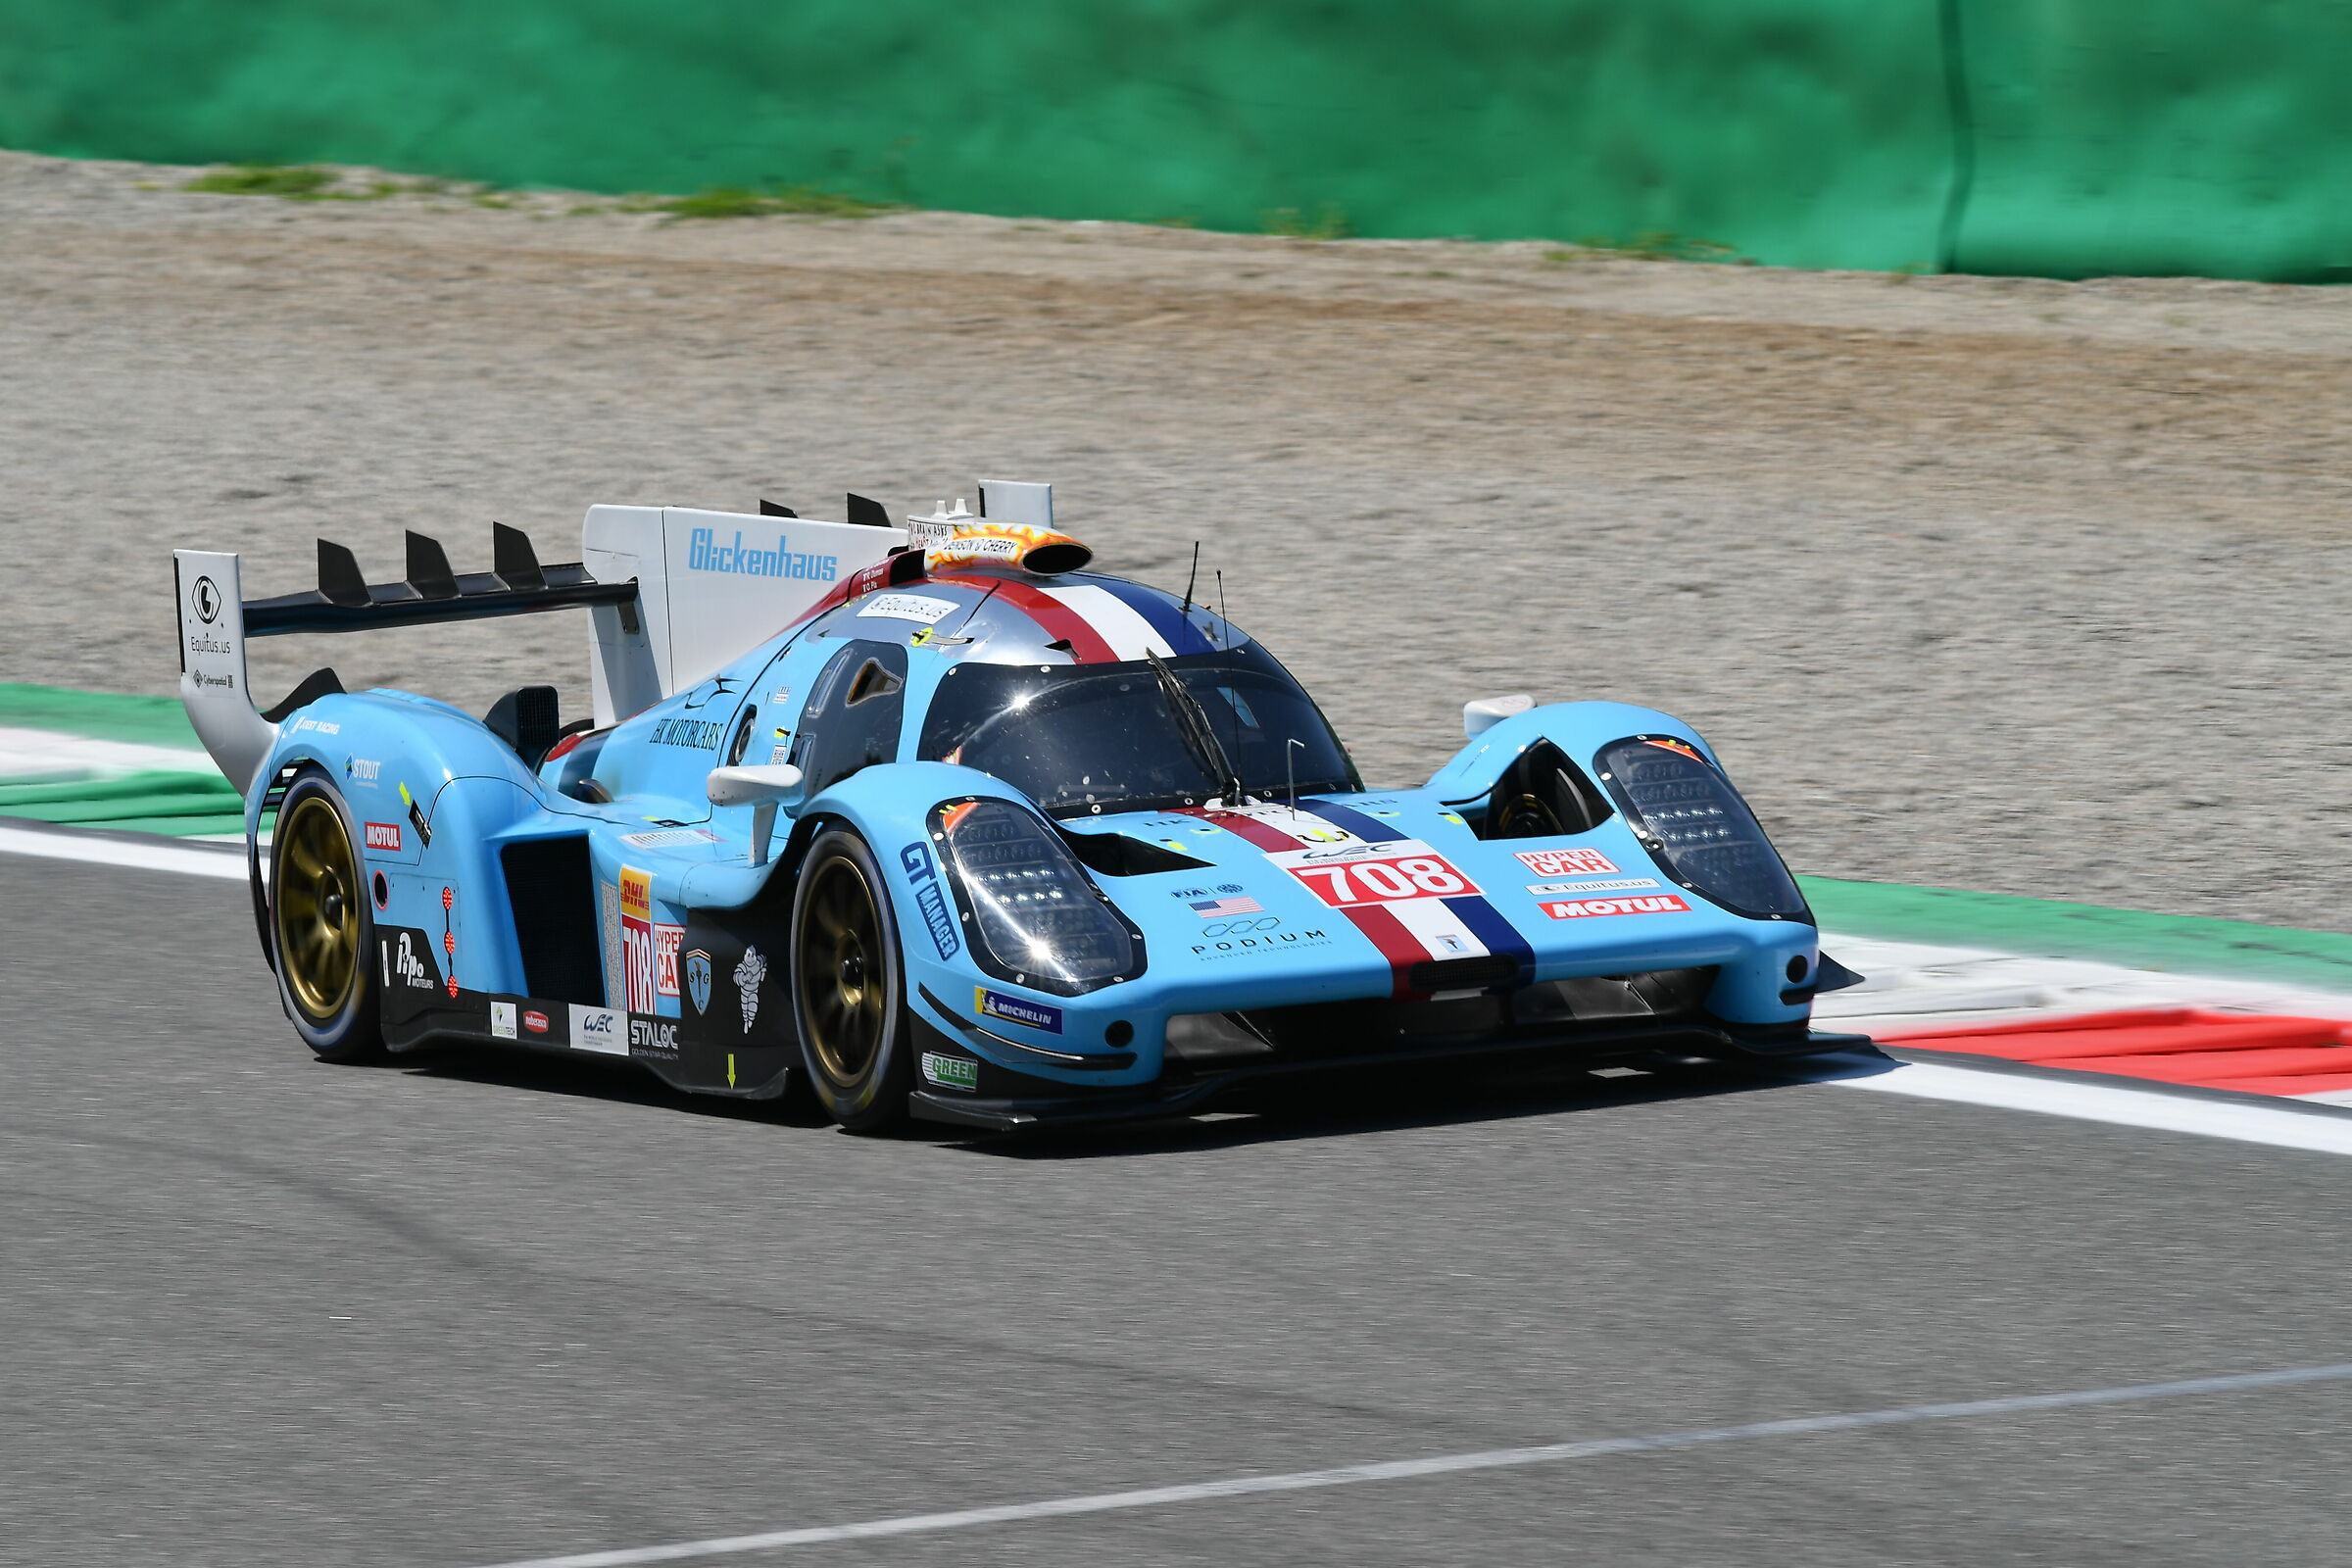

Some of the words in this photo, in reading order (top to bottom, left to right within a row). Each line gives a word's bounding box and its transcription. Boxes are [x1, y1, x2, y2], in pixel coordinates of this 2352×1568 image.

[689, 528, 837, 581] Glickenhaus
[983, 538, 1018, 554] CHERRY
[191, 636, 230, 656] Equitus.us
[649, 718, 672, 745] HK
[663, 718, 723, 752] MOTORCARS
[353, 759, 380, 781] STOUT
[367, 825, 400, 848] MOTUL
[900, 841, 937, 885] GT
[1302, 844, 1393, 859] WEC
[1523, 850, 1596, 862] HYPER
[1534, 858, 1611, 874] CAR
[1296, 858, 1465, 903] 708
[1563, 879, 1651, 891] Equitus.us
[621, 879, 650, 910] DHL
[1171, 887, 1207, 899] FIA
[1552, 897, 1684, 918] MOTUL
[918, 884, 957, 958] MANAGER
[1192, 929, 1326, 955] PODIUM
[396, 932, 424, 986] Pipo
[622, 926, 654, 1015] 708
[658, 953, 680, 989] CA
[412, 978, 433, 990] MOTEURS
[584, 1013, 614, 1033] WEC
[998, 1002, 1052, 1025] MICHELIN
[630, 1019, 678, 1051] STALOC
[933, 1057, 977, 1079] GREEN
